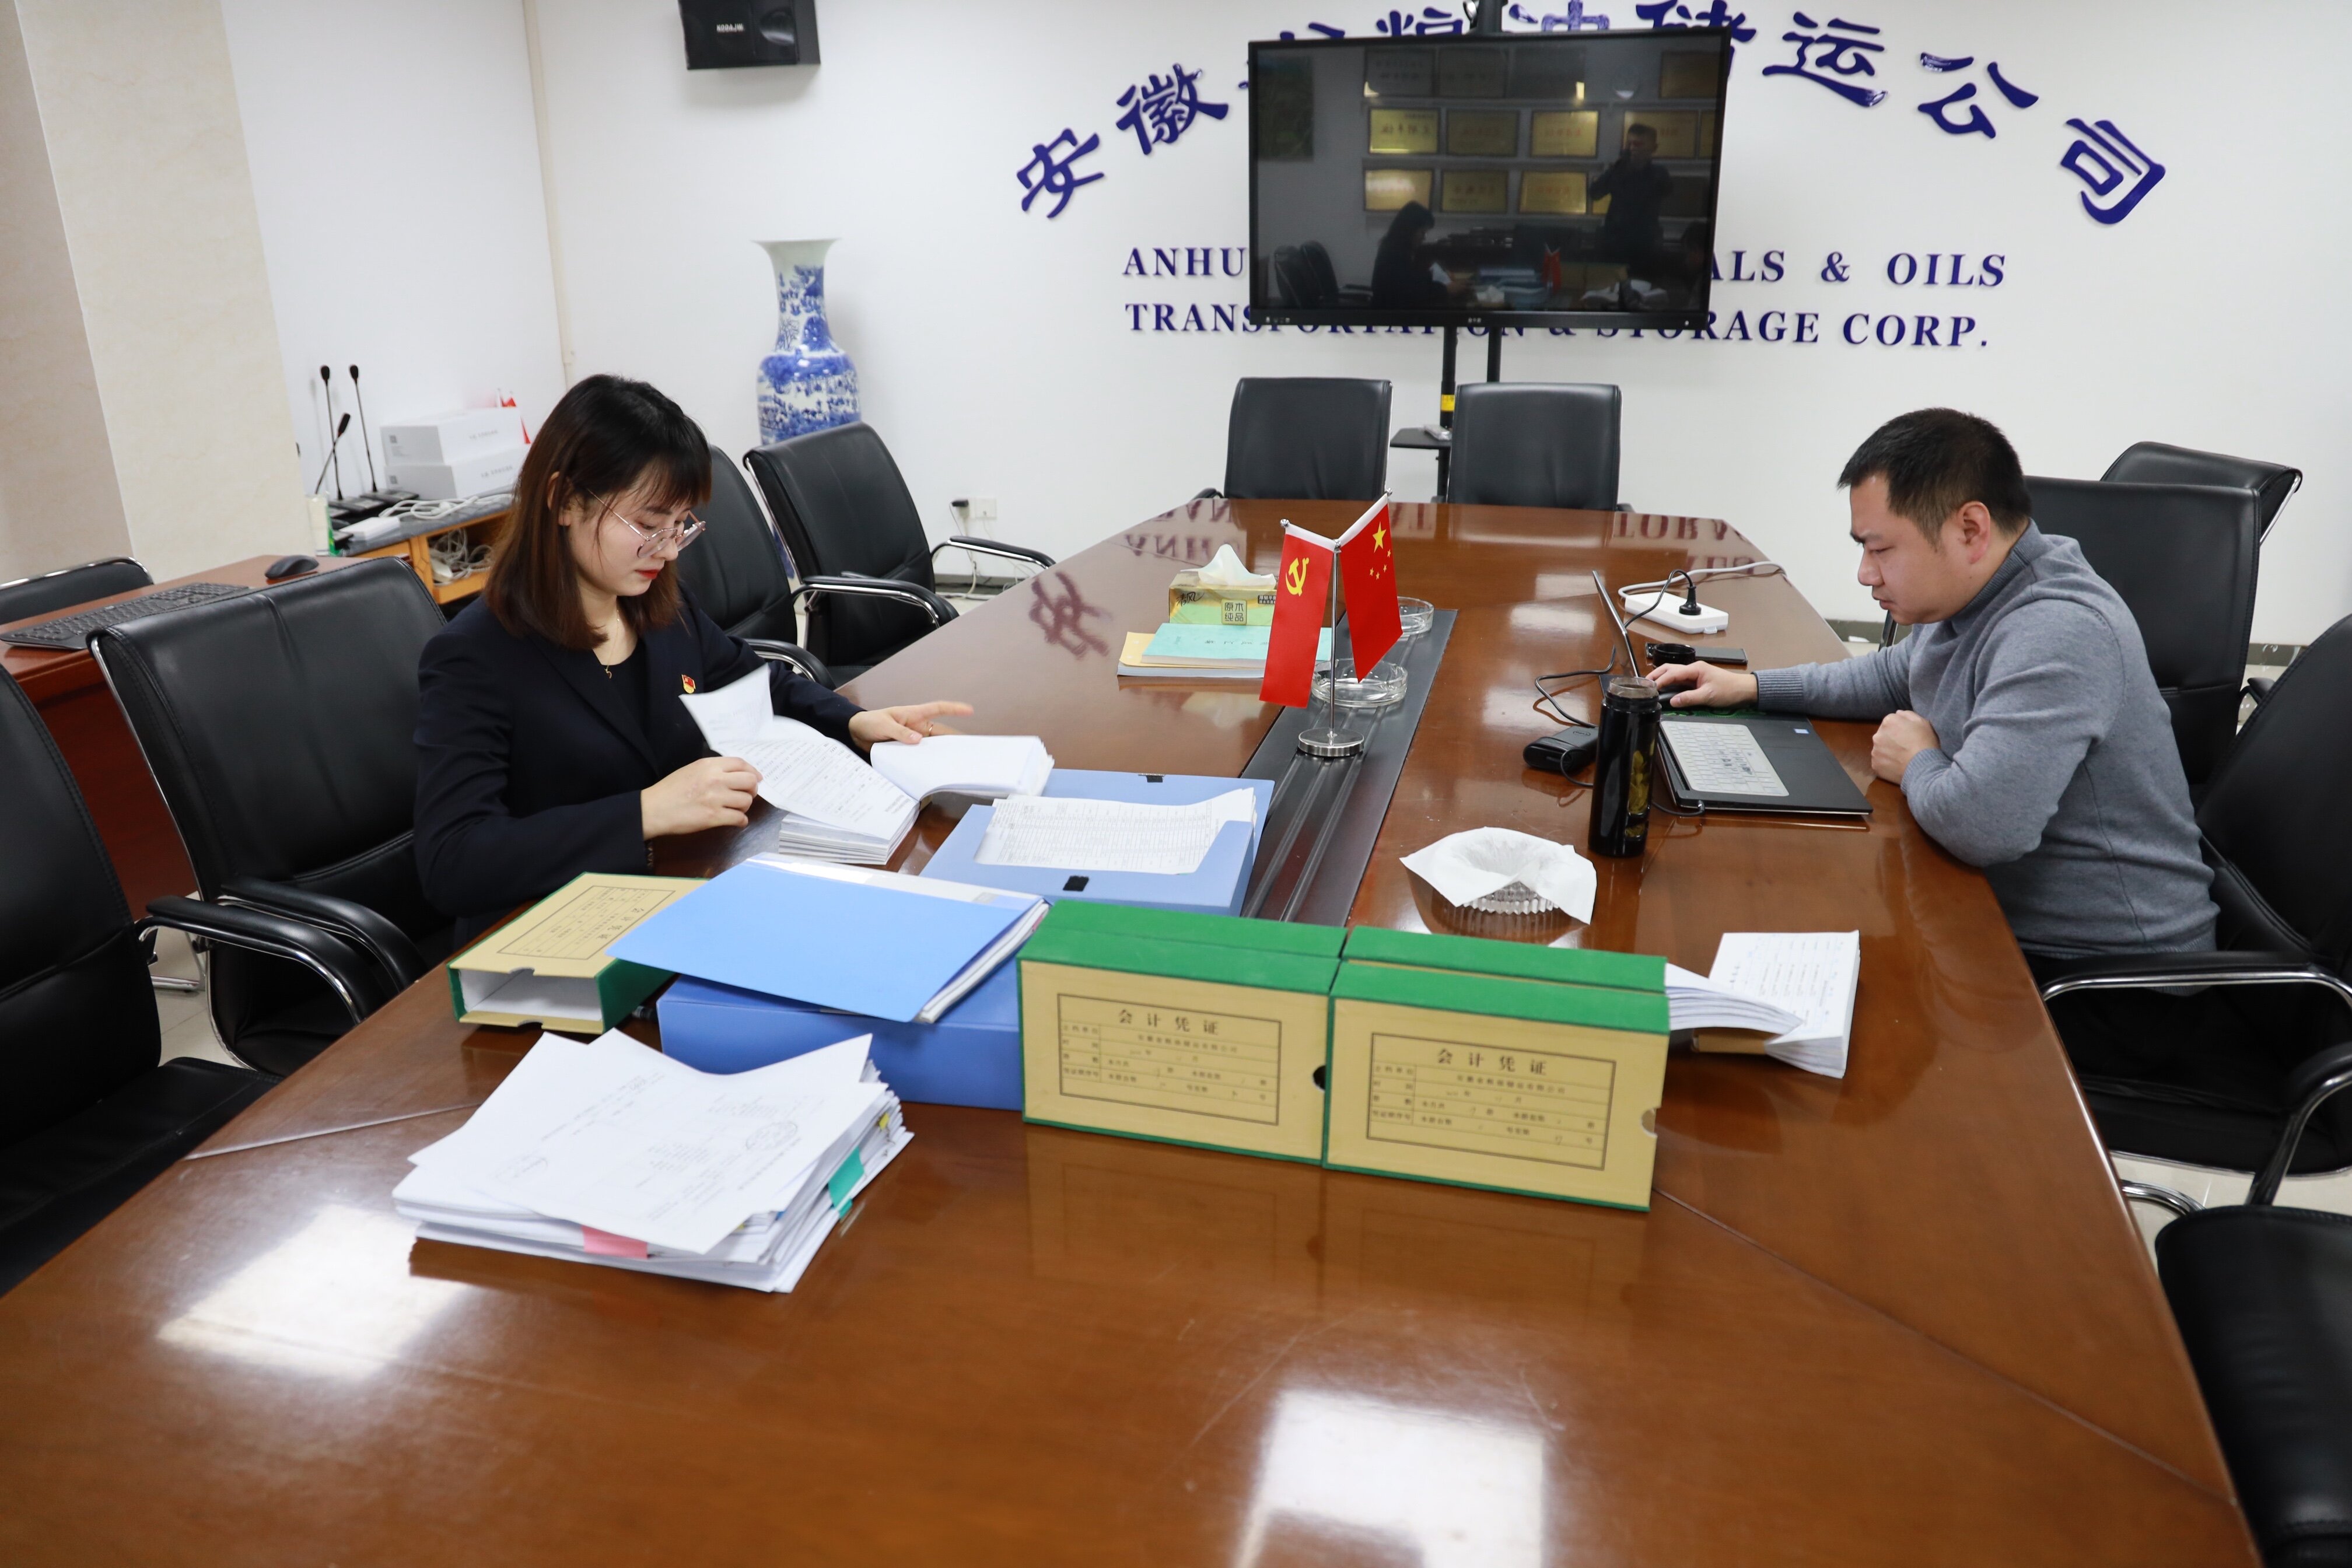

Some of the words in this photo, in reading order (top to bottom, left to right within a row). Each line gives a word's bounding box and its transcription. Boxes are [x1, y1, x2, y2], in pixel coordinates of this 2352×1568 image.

[1123, 247, 1245, 276] ANHU
[1821, 251, 1850, 282] &
[1887, 253, 2006, 286] OILS
[1842, 312, 1987, 346] CORP.
[1177, 592, 1204, 607] 清风
[1225, 603, 1244, 612] 原木
[1225, 612, 1244, 622] 纯品
[1119, 1009, 1219, 1035] 会计凭证
[1437, 1048, 1546, 1075] 会计凭证
